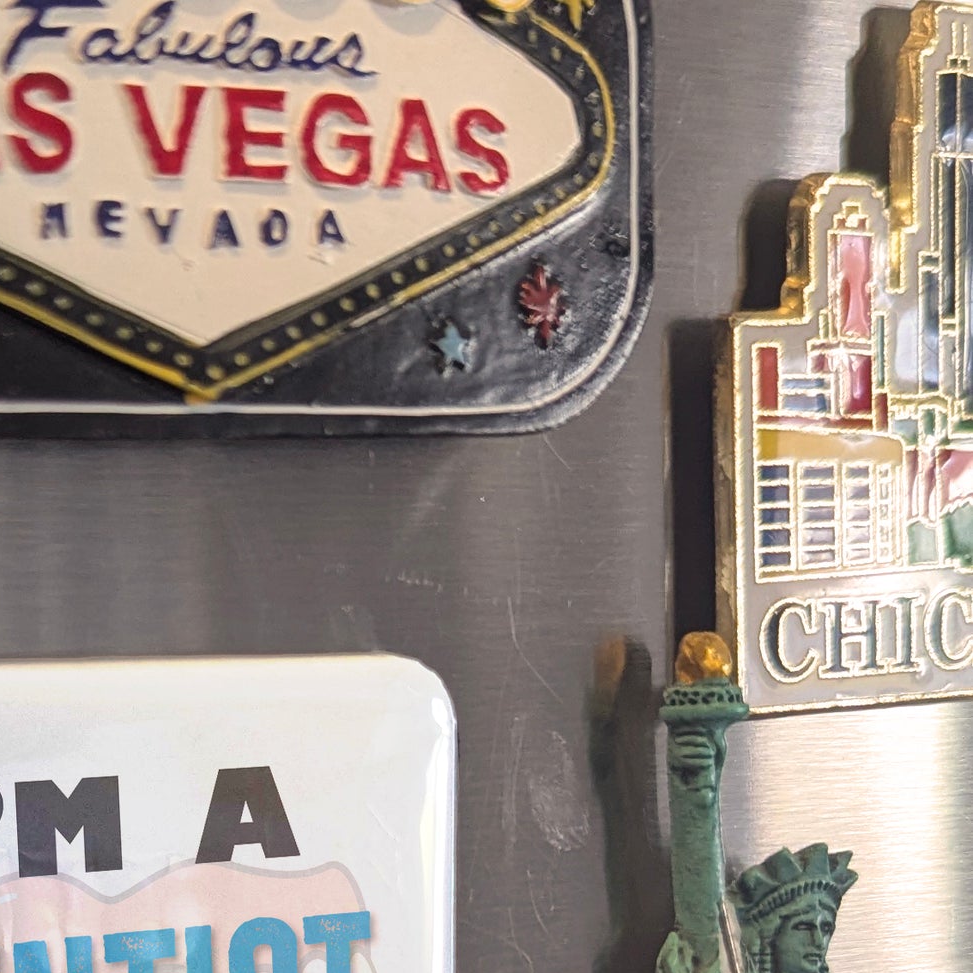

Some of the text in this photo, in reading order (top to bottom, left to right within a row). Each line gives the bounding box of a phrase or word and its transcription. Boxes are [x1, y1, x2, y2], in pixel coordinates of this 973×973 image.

[1, 0, 379, 77] Fabulous
[123, 84, 509, 195] VEGAS
[39, 200, 347, 250] NEVADA
[195, 766, 301, 864] A
